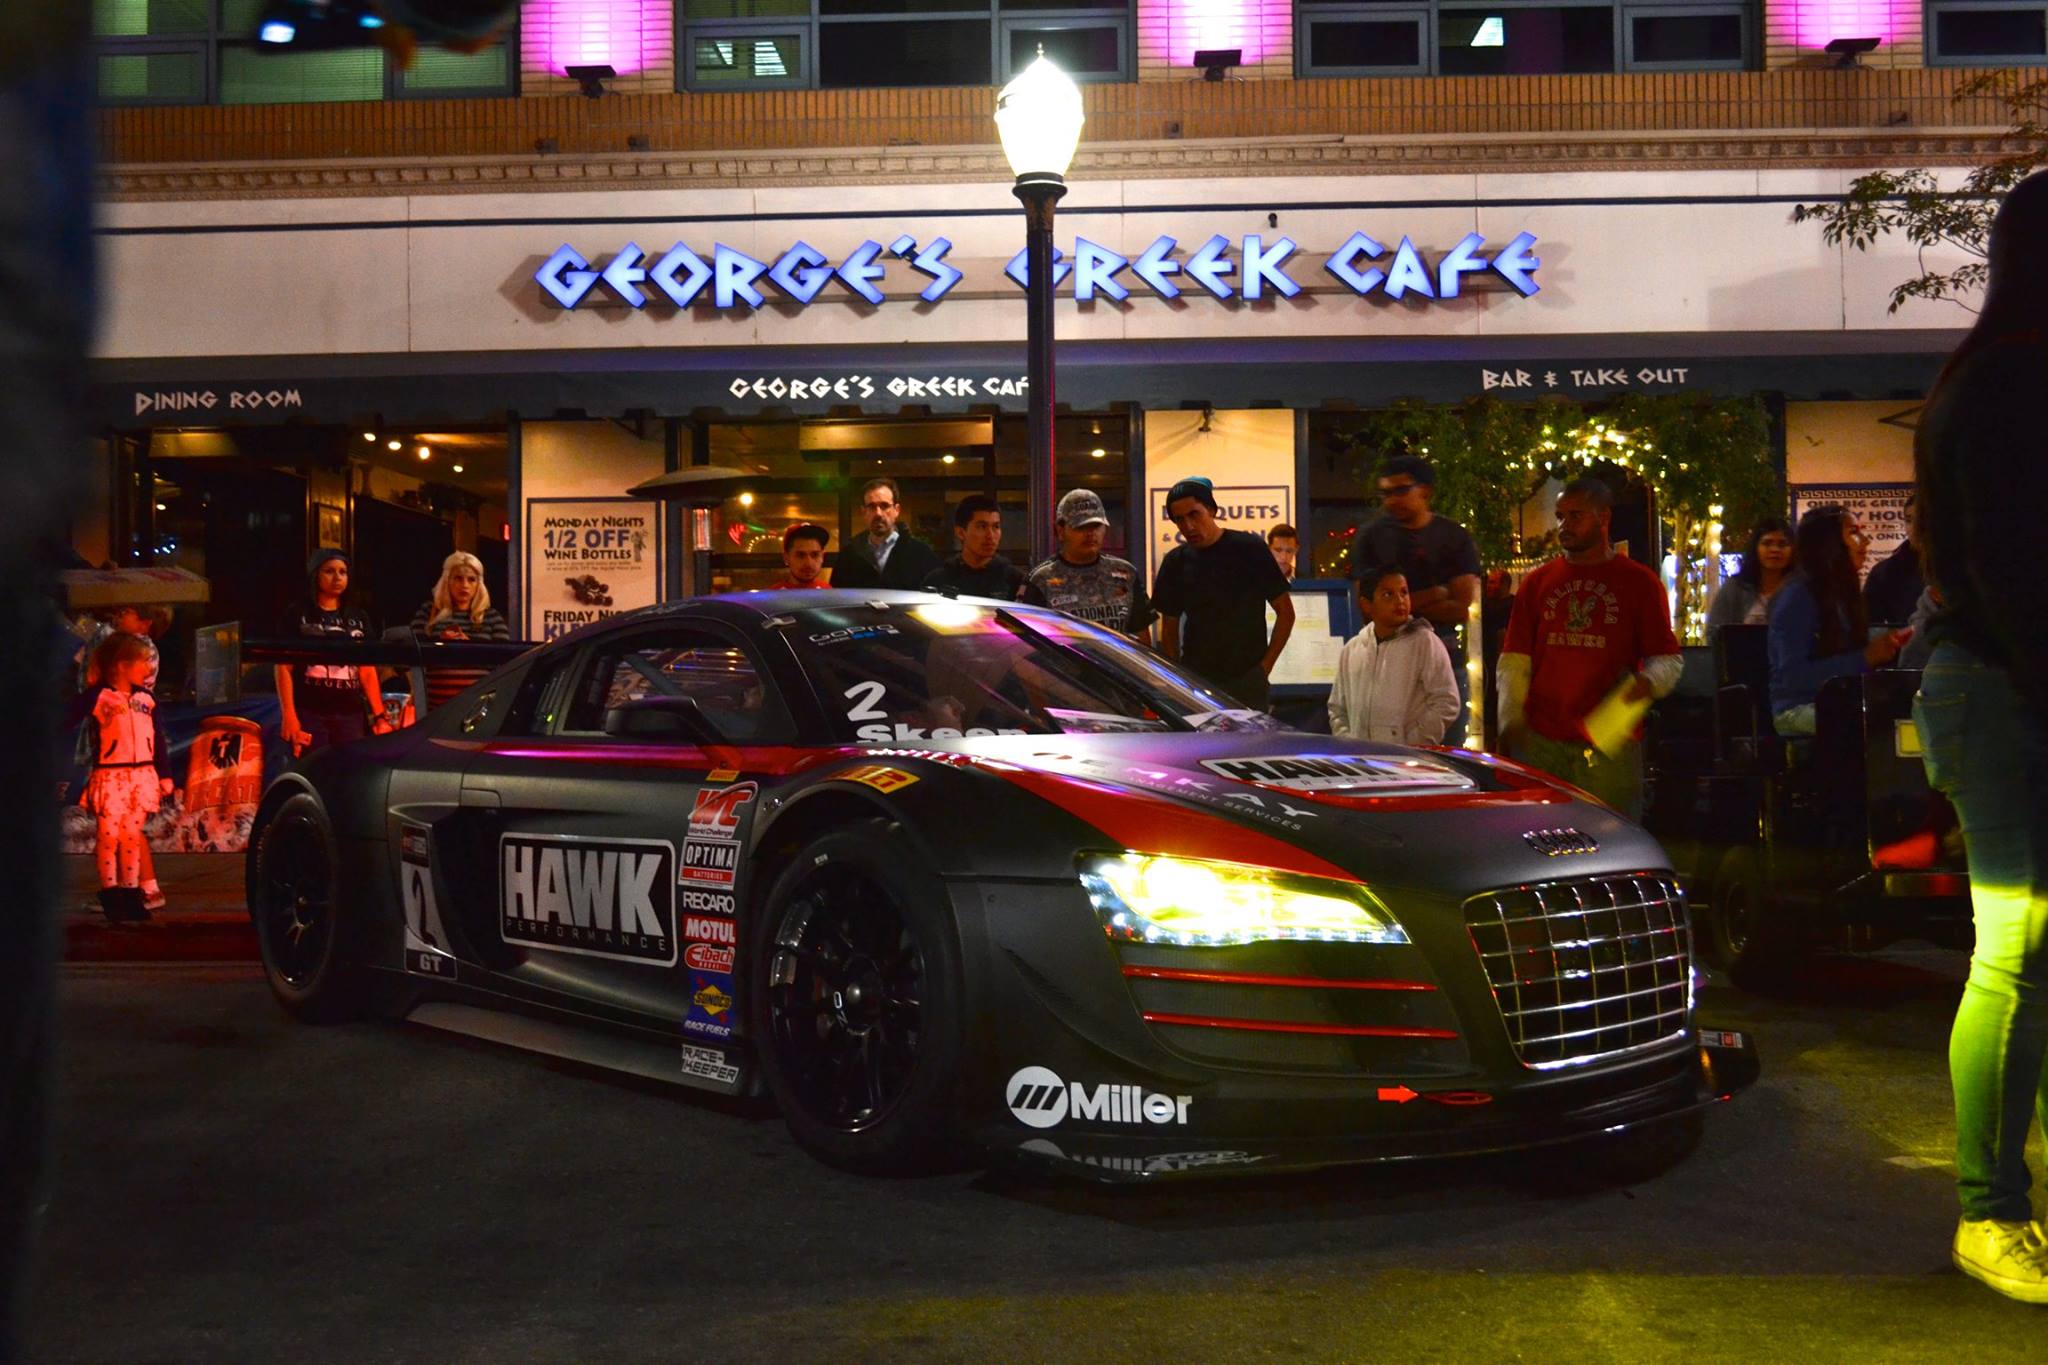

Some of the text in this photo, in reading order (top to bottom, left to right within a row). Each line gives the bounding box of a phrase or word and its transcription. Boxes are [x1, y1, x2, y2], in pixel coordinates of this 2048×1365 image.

[534, 234, 964, 310] GEORGE'S
[729, 375, 1029, 400] GEORGE'S GREEK CAF
[1482, 368, 1533, 390] BAR
[1570, 367, 1630, 387] TAKE
[1636, 367, 1689, 385] OUT
[135, 388, 303, 417] DINING ROOM
[1162, 505, 1280, 521] QUETS
[1843, 500, 1866, 508] BIG
[1869, 510, 1907, 521] HOU
[544, 515, 644, 528] MONDAY NIGHTS
[544, 529, 631, 549] 1/2 OFF
[1875, 532, 1907, 541] ONLY
[544, 548, 632, 560] WINE BOTTLES
[1068, 604, 1119, 620] ATIONAL
[1543, 579, 1620, 624] CALIFORNIA
[544, 609, 594, 623] FRIDAY
[844, 681, 888, 722] 2
[1213, 756, 1399, 782] HAWK
[1223, 801, 1302, 831] SERVICES
[686, 844, 735, 868] OPTIMA
[504, 845, 665, 937] HAWK
[683, 891, 736, 914] RECARO
[504, 918, 667, 951] PERFORMANCE
[684, 917, 737, 944] MOTUL
[419, 953, 442, 973] GT
[694, 991, 731, 1008] SUNOCO
[684, 1019, 731, 1037] RACE FUELS
[684, 1061, 738, 1081] KEEPER
[1070, 1081, 1193, 1125] Miller
